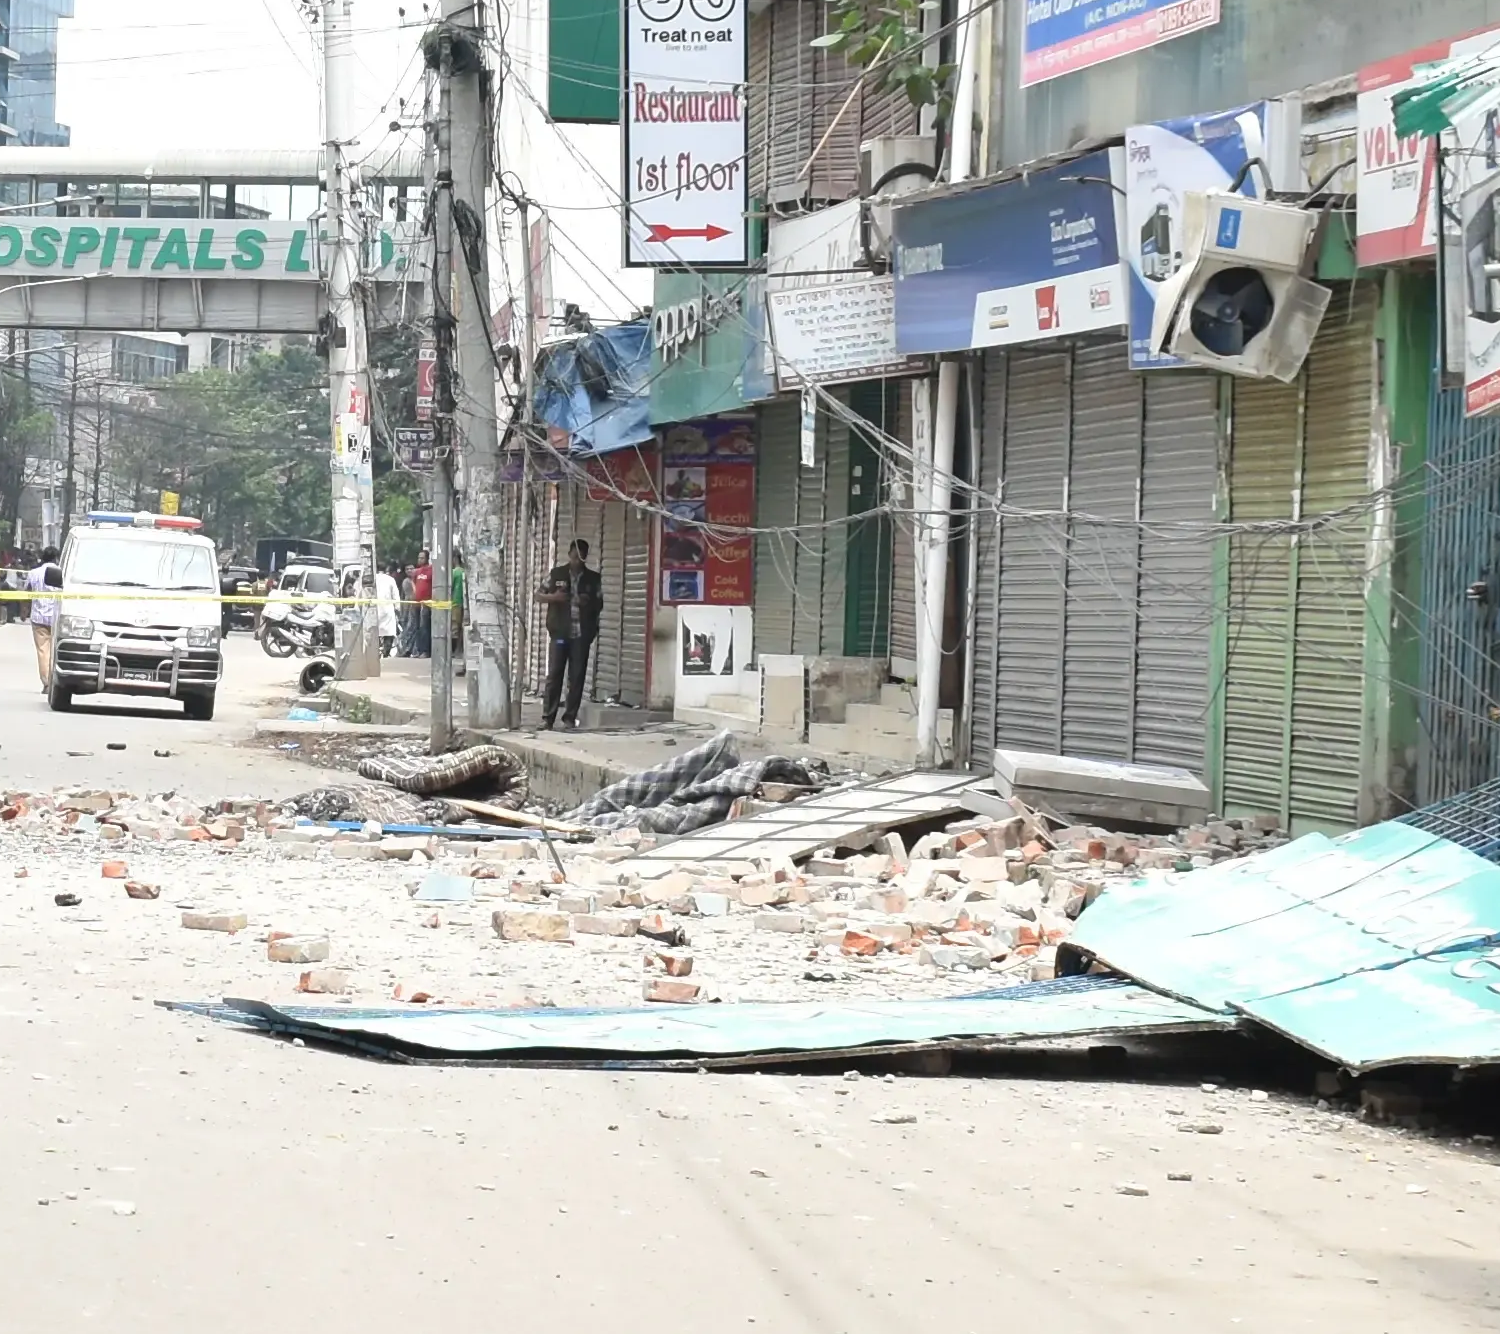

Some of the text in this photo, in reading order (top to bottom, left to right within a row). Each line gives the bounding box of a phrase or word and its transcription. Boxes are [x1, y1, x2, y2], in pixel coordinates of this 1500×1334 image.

[641, 27, 733, 44] Treat n eat
[633, 82, 741, 123] Restaurant
[635, 151, 740, 202] 1st floor
[654, 298, 701, 363] oppo
[709, 473, 748, 489] Juice
[707, 511, 750, 526] Lacchi
[706, 544, 750, 560] Coffee
[713, 575, 739, 586] Cold
[709, 587, 745, 600] Coffee
